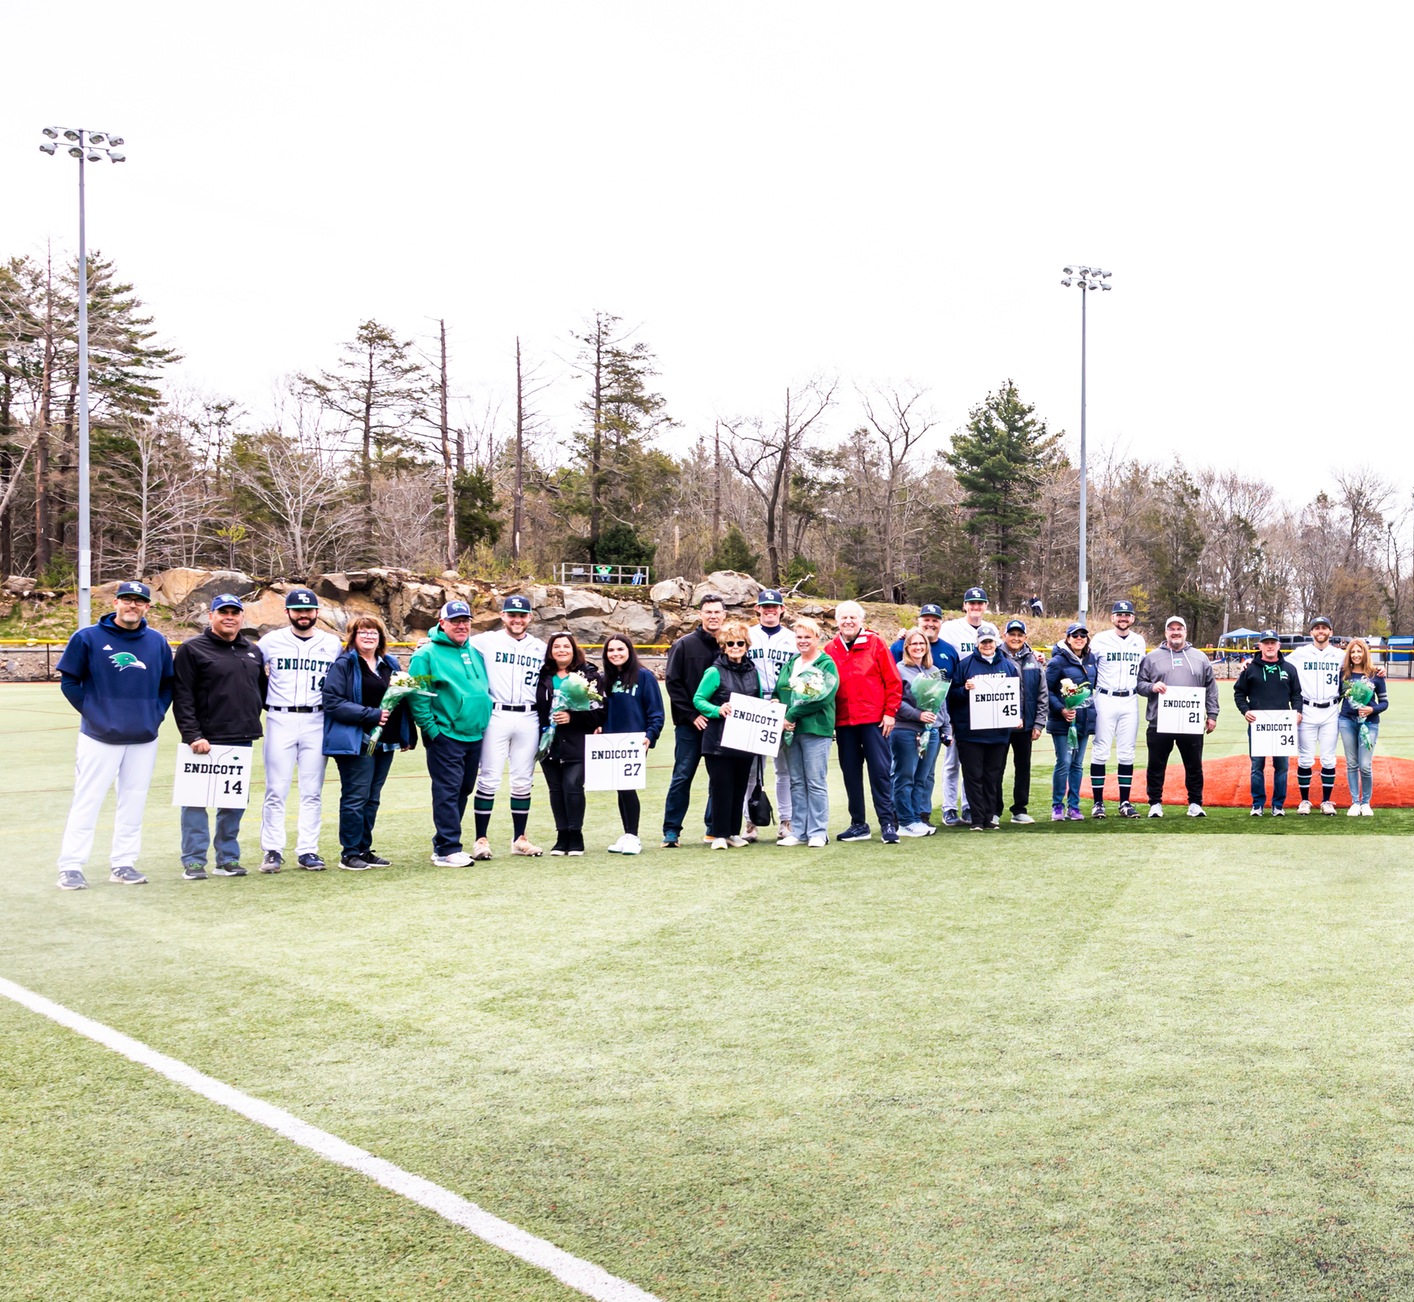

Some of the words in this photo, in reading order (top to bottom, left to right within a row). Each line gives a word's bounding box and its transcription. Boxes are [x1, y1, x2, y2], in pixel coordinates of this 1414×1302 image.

[748, 648, 794, 661] ENDICOTT
[1107, 652, 1140, 662] ENDICOTT
[277, 658, 330, 673] ENDICOTT
[495, 652, 542, 670] ENDICOTT
[1304, 662, 1339, 671] ENDICOTT
[775, 662, 786, 676] 3
[1130, 664, 1138, 676] 21
[311, 676, 326, 691] 14
[525, 671, 540, 687] 27
[1326, 674, 1338, 686] 34
[975, 692, 1014, 702] ENDICOTT
[1164, 700, 1200, 708] ENDICOTT
[1002, 705, 1018, 716] 45
[733, 710, 778, 726] ENDICOTT
[1188, 712, 1200, 723] 21
[760, 730, 778, 744] 35
[1280, 735, 1294, 746] 34
[592, 750, 639, 760] ENDICOTT
[184, 763, 243, 776] ENDICOTT
[624, 764, 641, 776] 27
[224, 780, 242, 794] 14
